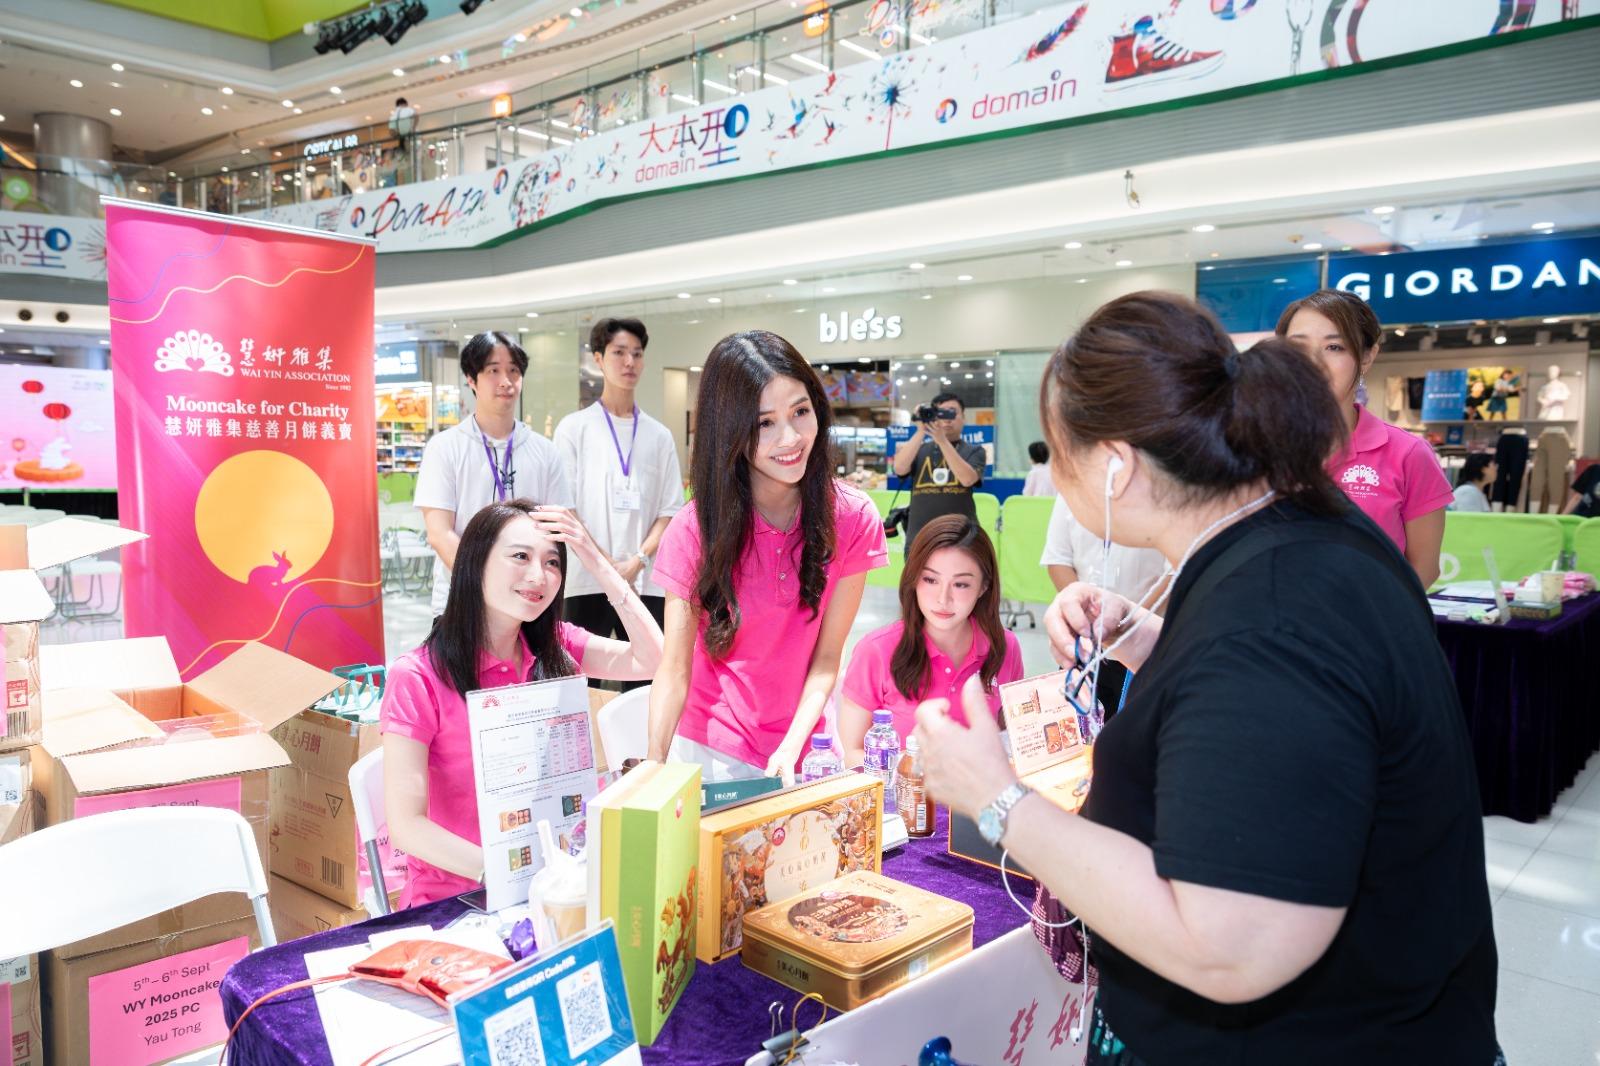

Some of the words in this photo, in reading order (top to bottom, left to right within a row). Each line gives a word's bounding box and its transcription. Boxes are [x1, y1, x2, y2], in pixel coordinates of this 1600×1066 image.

[972, 69, 1077, 120] domain
[639, 103, 750, 169] 大本型
[635, 149, 696, 183] domain
[819, 308, 903, 343] bless
[240, 368, 261, 378] WAI
[263, 370, 283, 379] YIN
[284, 371, 351, 383] ASSOCIATION
[166, 395, 256, 415] Mooncake
[260, 400, 285, 415] for
[288, 401, 349, 421] Charity
[165, 416, 353, 441] 慧妍雅集慈善月餅義賣
[181, 962, 211, 979] Sept
[122, 998, 147, 1014] WY
[150, 979, 220, 1007] Mooncake
[145, 1008, 178, 1027] 2025
[181, 1002, 201, 1017] PC
[144, 1032, 168, 1046] Yau
[171, 1022, 202, 1039] Tong
